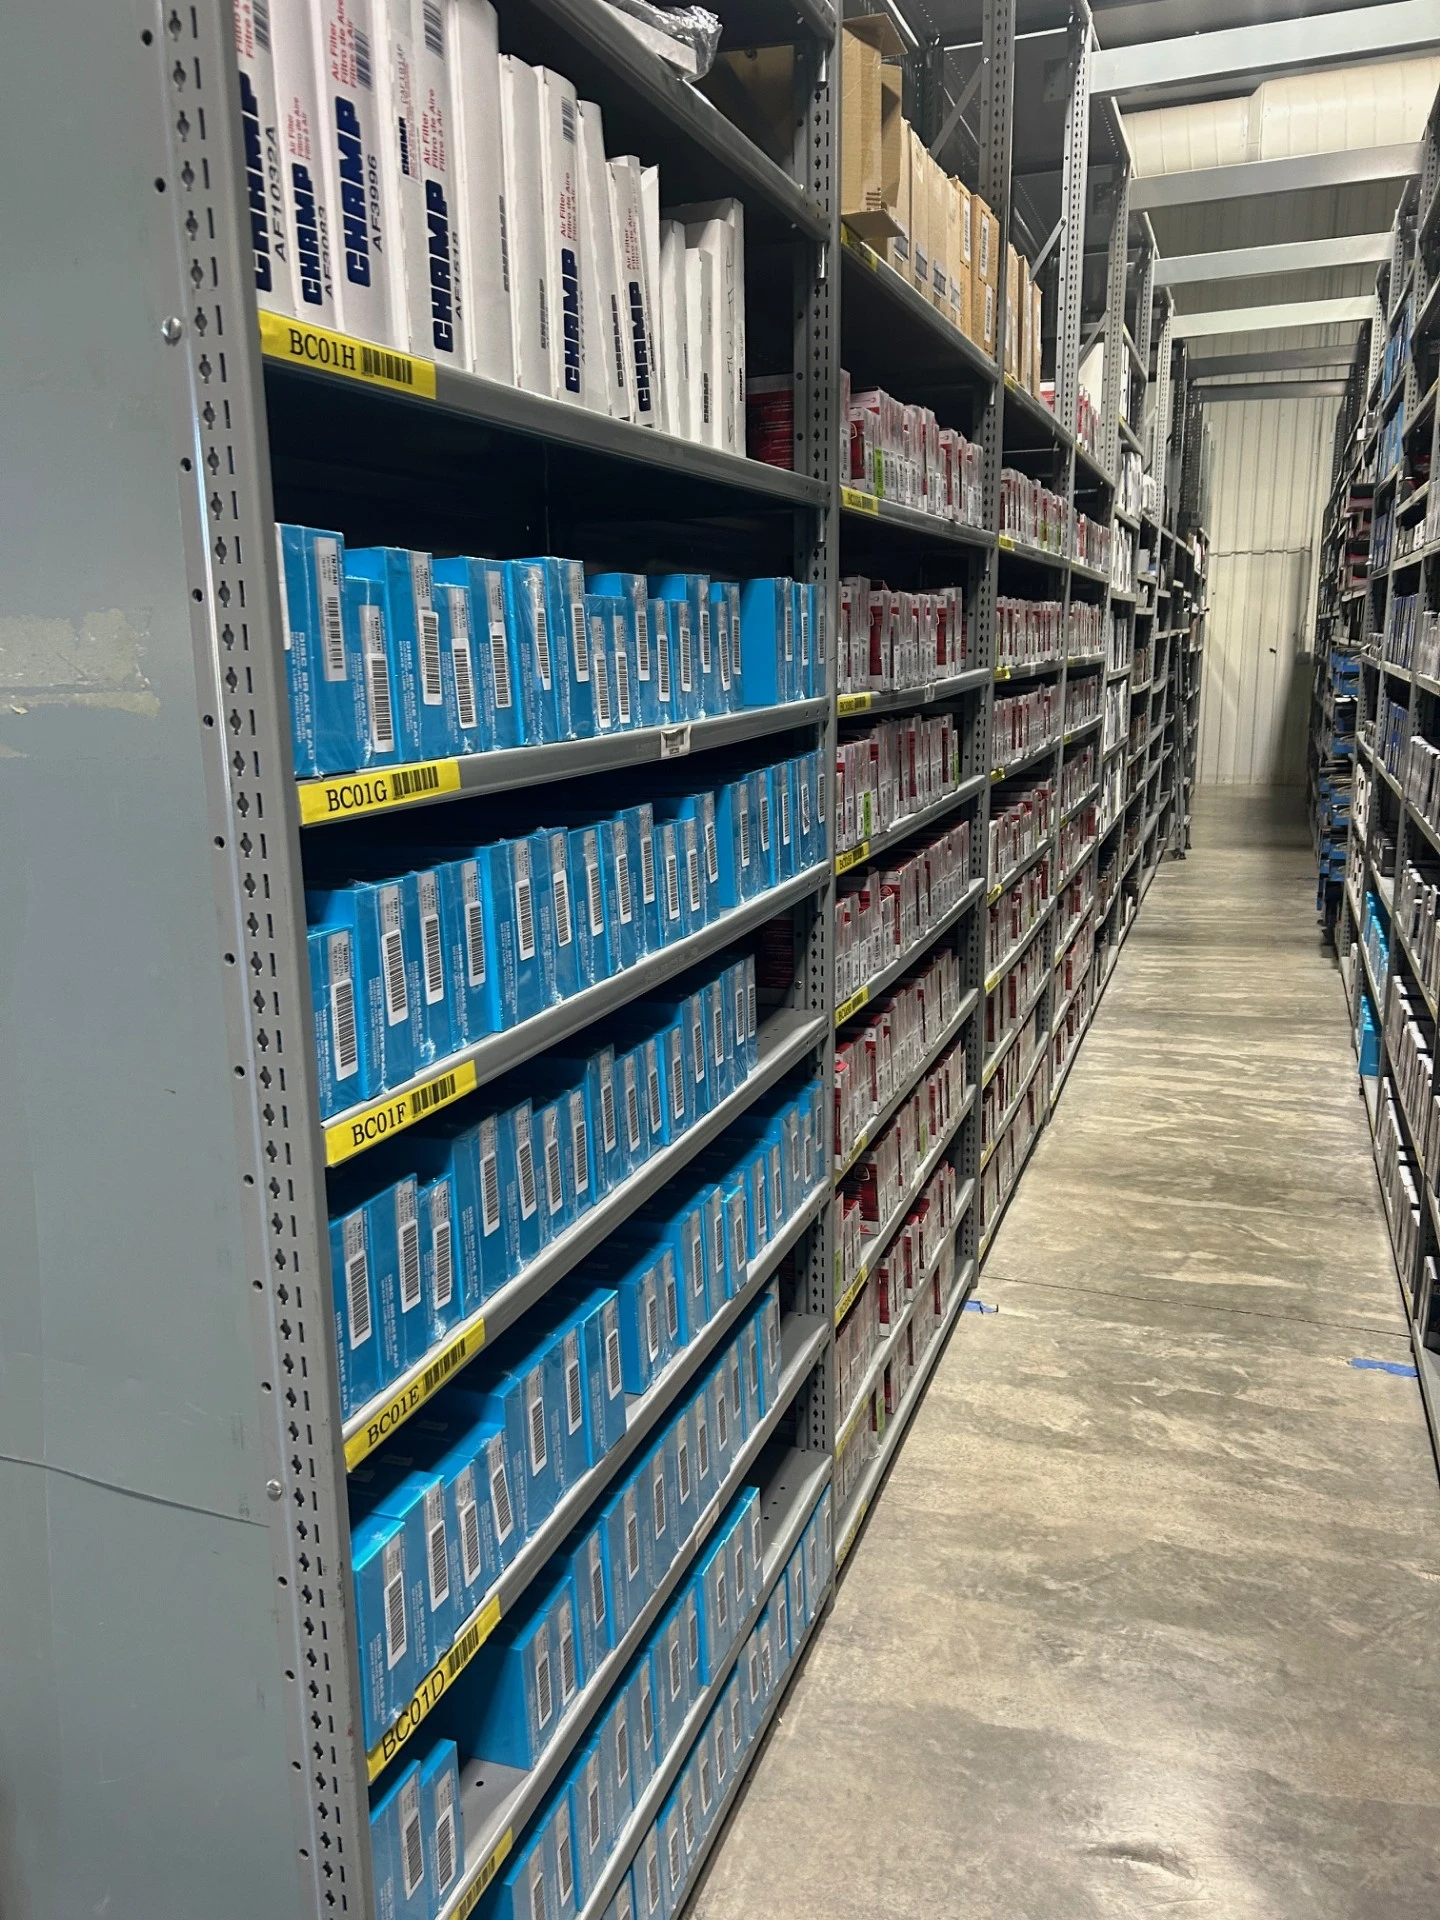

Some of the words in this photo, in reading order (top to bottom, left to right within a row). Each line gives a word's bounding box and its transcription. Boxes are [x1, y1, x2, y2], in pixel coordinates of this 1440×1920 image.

[330, 20, 338, 57] Filter
[339, 27, 346, 46] de
[341, 49, 349, 84] Filtro
[349, 53, 357, 88] Filtre
[398, 116, 410, 176] CHAMP
[422, 112, 430, 144] Filter
[423, 147, 431, 166] Air
[265, 125, 287, 264] AF1032A
[335, 95, 371, 288] CHAMP
[367, 154, 384, 254] AF3996
[292, 162, 323, 306] CHAMP
[425, 179, 454, 353] CHAMP
[561, 248, 580, 393] CHAMP
[611, 294, 624, 387] CHAMP
[288, 328, 356, 371] BC01H
[629, 281, 652, 412] CHAMP
[299, 632, 308, 666] DISC
[406, 641, 414, 669] DISC
[302, 671, 311, 723] BRAKE
[359, 685, 367, 725] BRAKE
[408, 674, 416, 717] BRAKE
[326, 780, 388, 812] BC01G
[352, 1102, 407, 1146] BC01F
[366, 1385, 420, 1447] BC01E
[383, 1670, 445, 1761] BC01D
